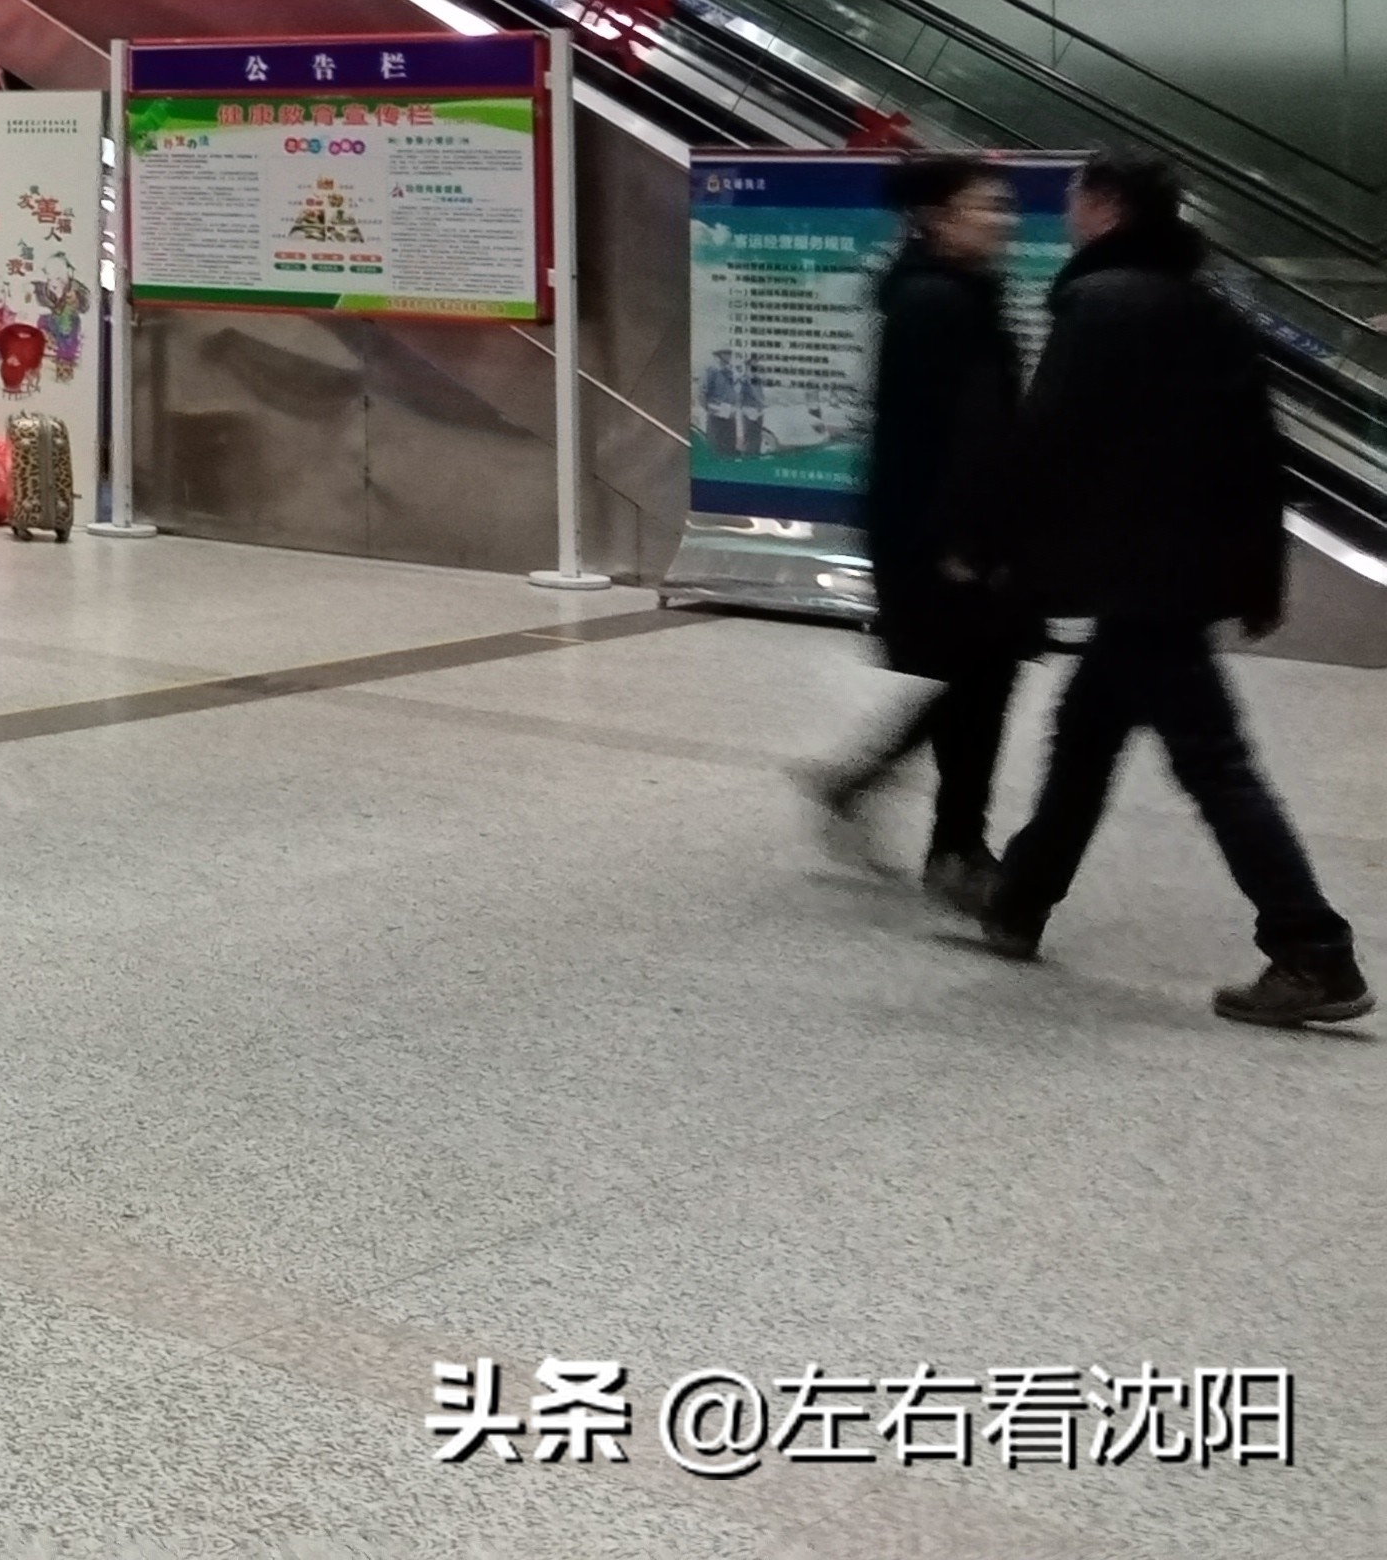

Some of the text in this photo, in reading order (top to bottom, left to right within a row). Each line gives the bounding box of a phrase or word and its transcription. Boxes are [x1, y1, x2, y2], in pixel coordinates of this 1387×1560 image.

[245, 51, 408, 82] 公告栏
[217, 103, 435, 128] 健康教育宣传栏
